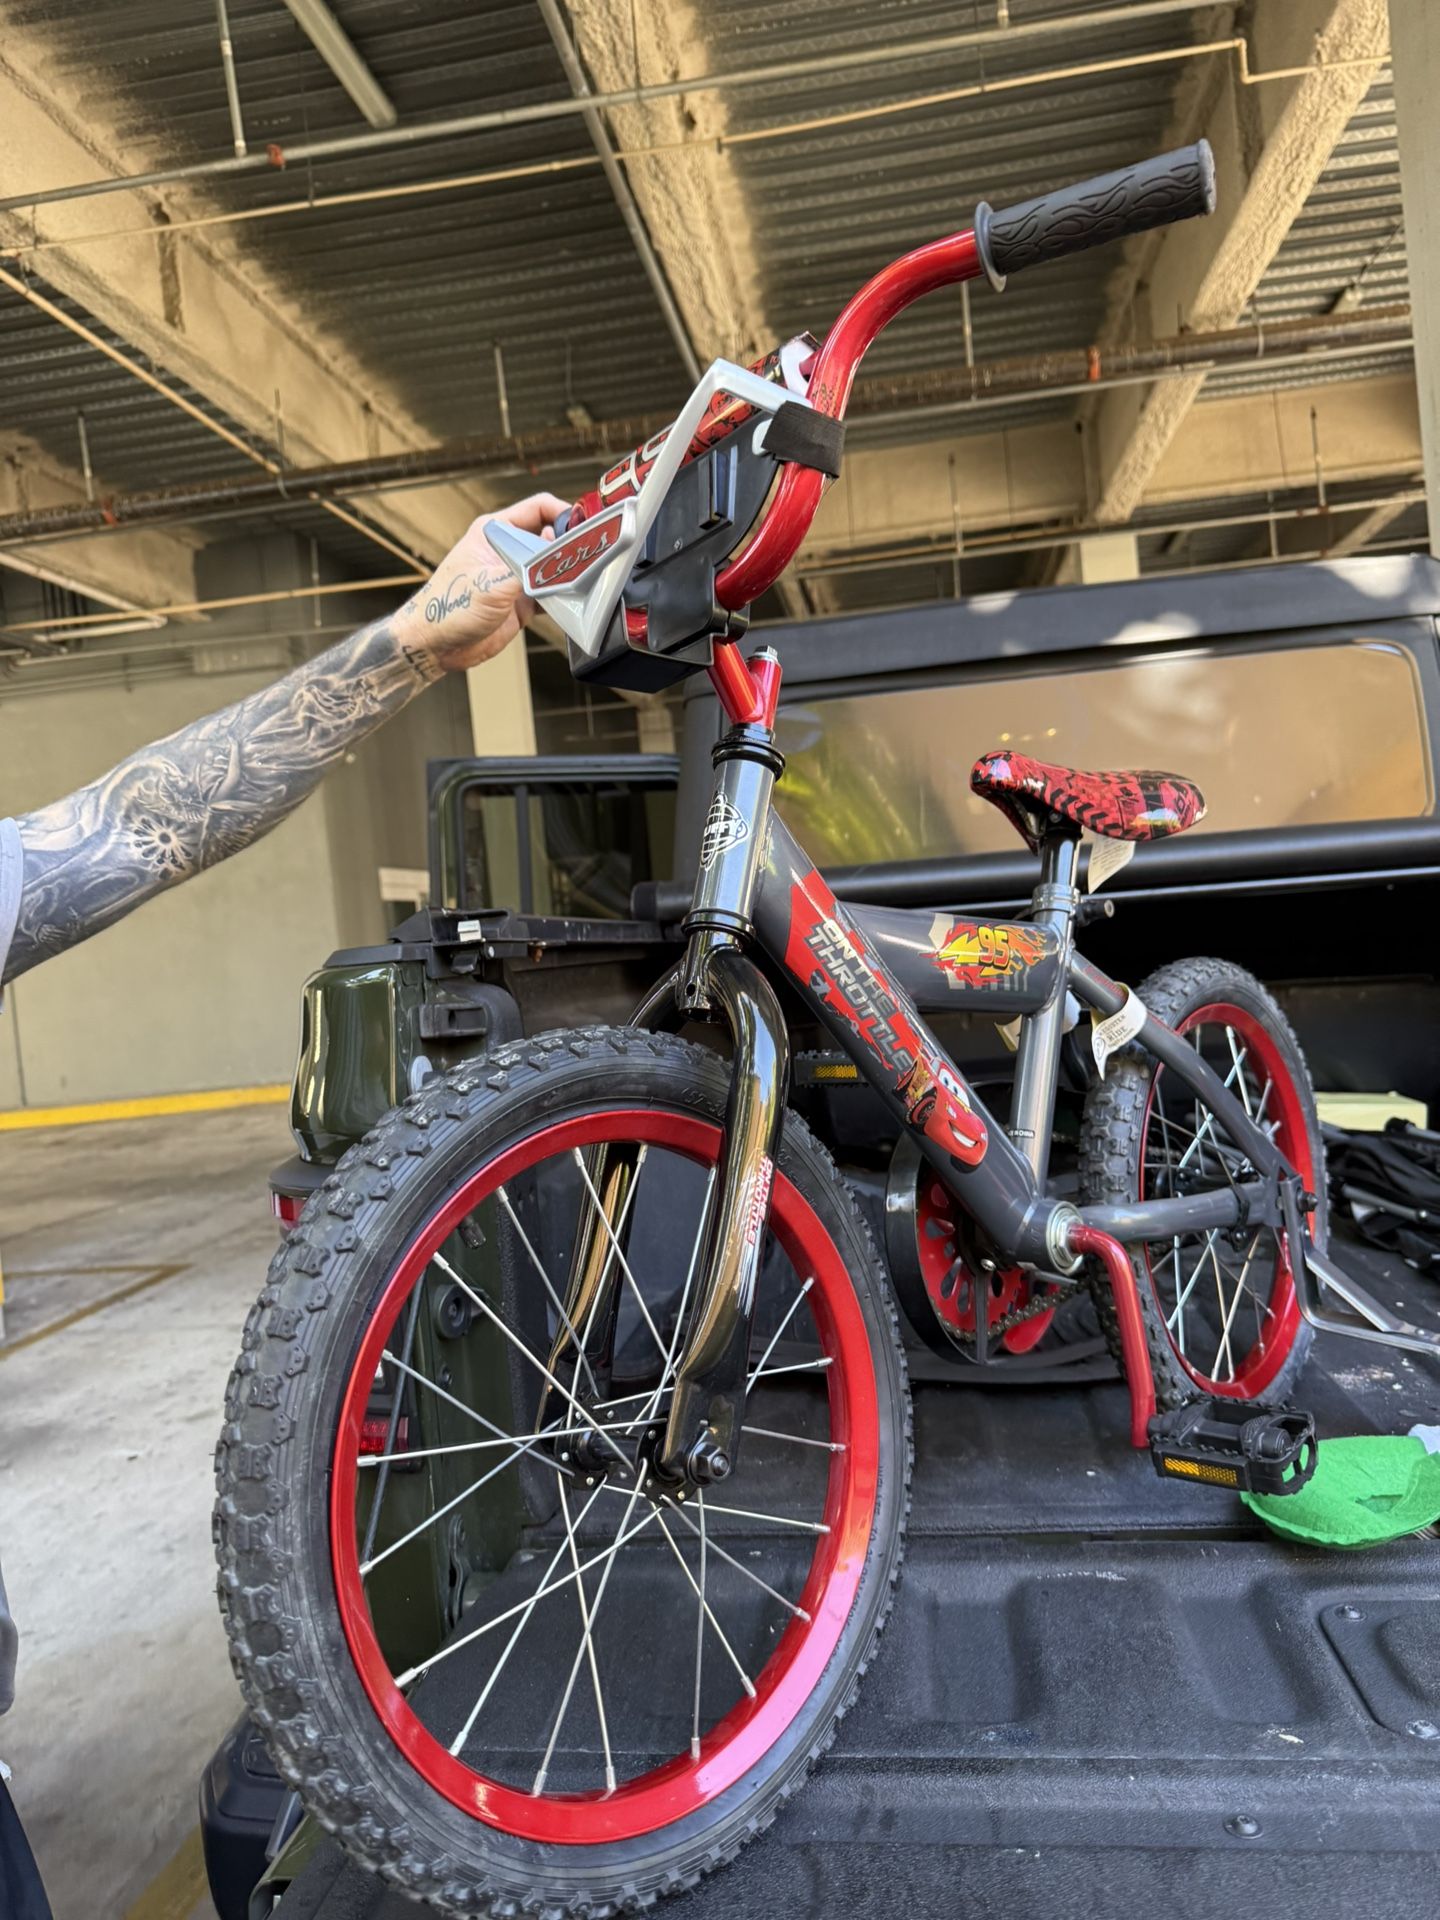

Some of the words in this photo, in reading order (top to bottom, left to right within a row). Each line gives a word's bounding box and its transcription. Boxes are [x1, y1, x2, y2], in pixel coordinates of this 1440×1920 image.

[536, 531, 612, 585] Cars
[977, 925, 1010, 968] 95
[809, 926, 913, 1072] THROTTLE
[747, 1156, 768, 1246] THROTTLE
